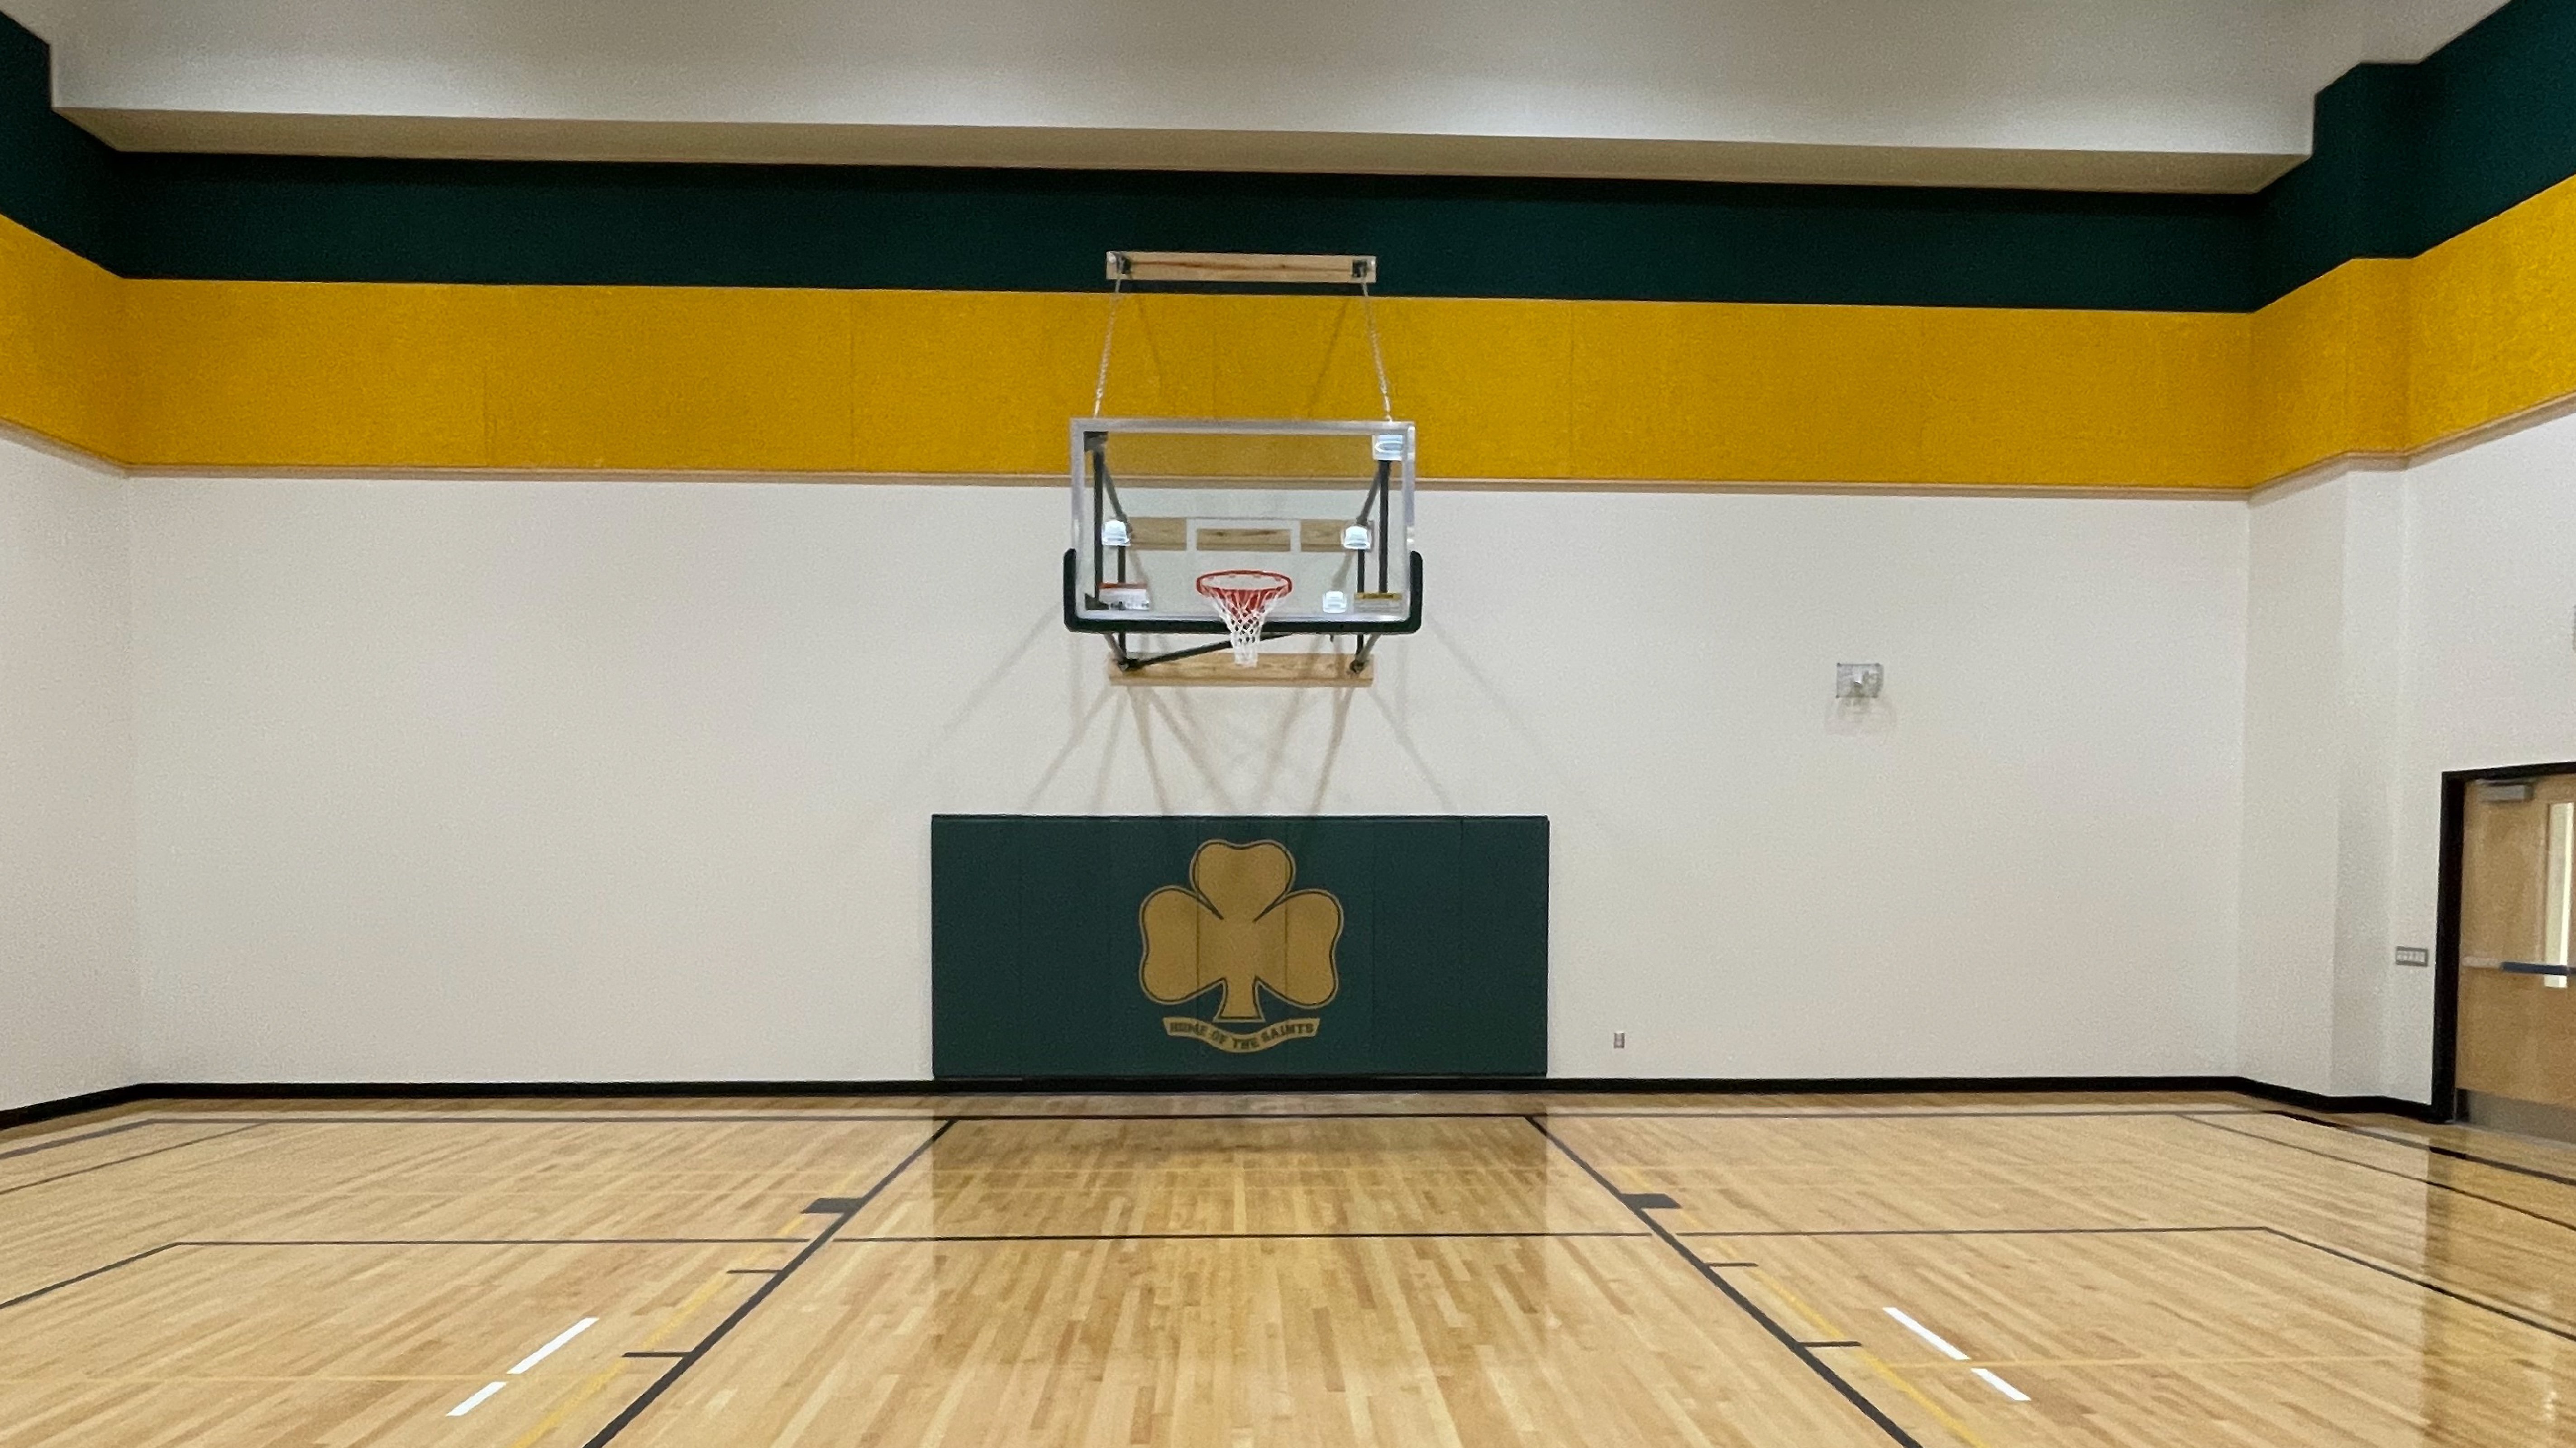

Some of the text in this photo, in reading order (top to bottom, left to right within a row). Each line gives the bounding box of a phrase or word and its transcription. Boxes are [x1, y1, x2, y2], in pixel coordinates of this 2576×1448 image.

[1169, 1022, 1314, 1050] HOME OF THE SAINTS
